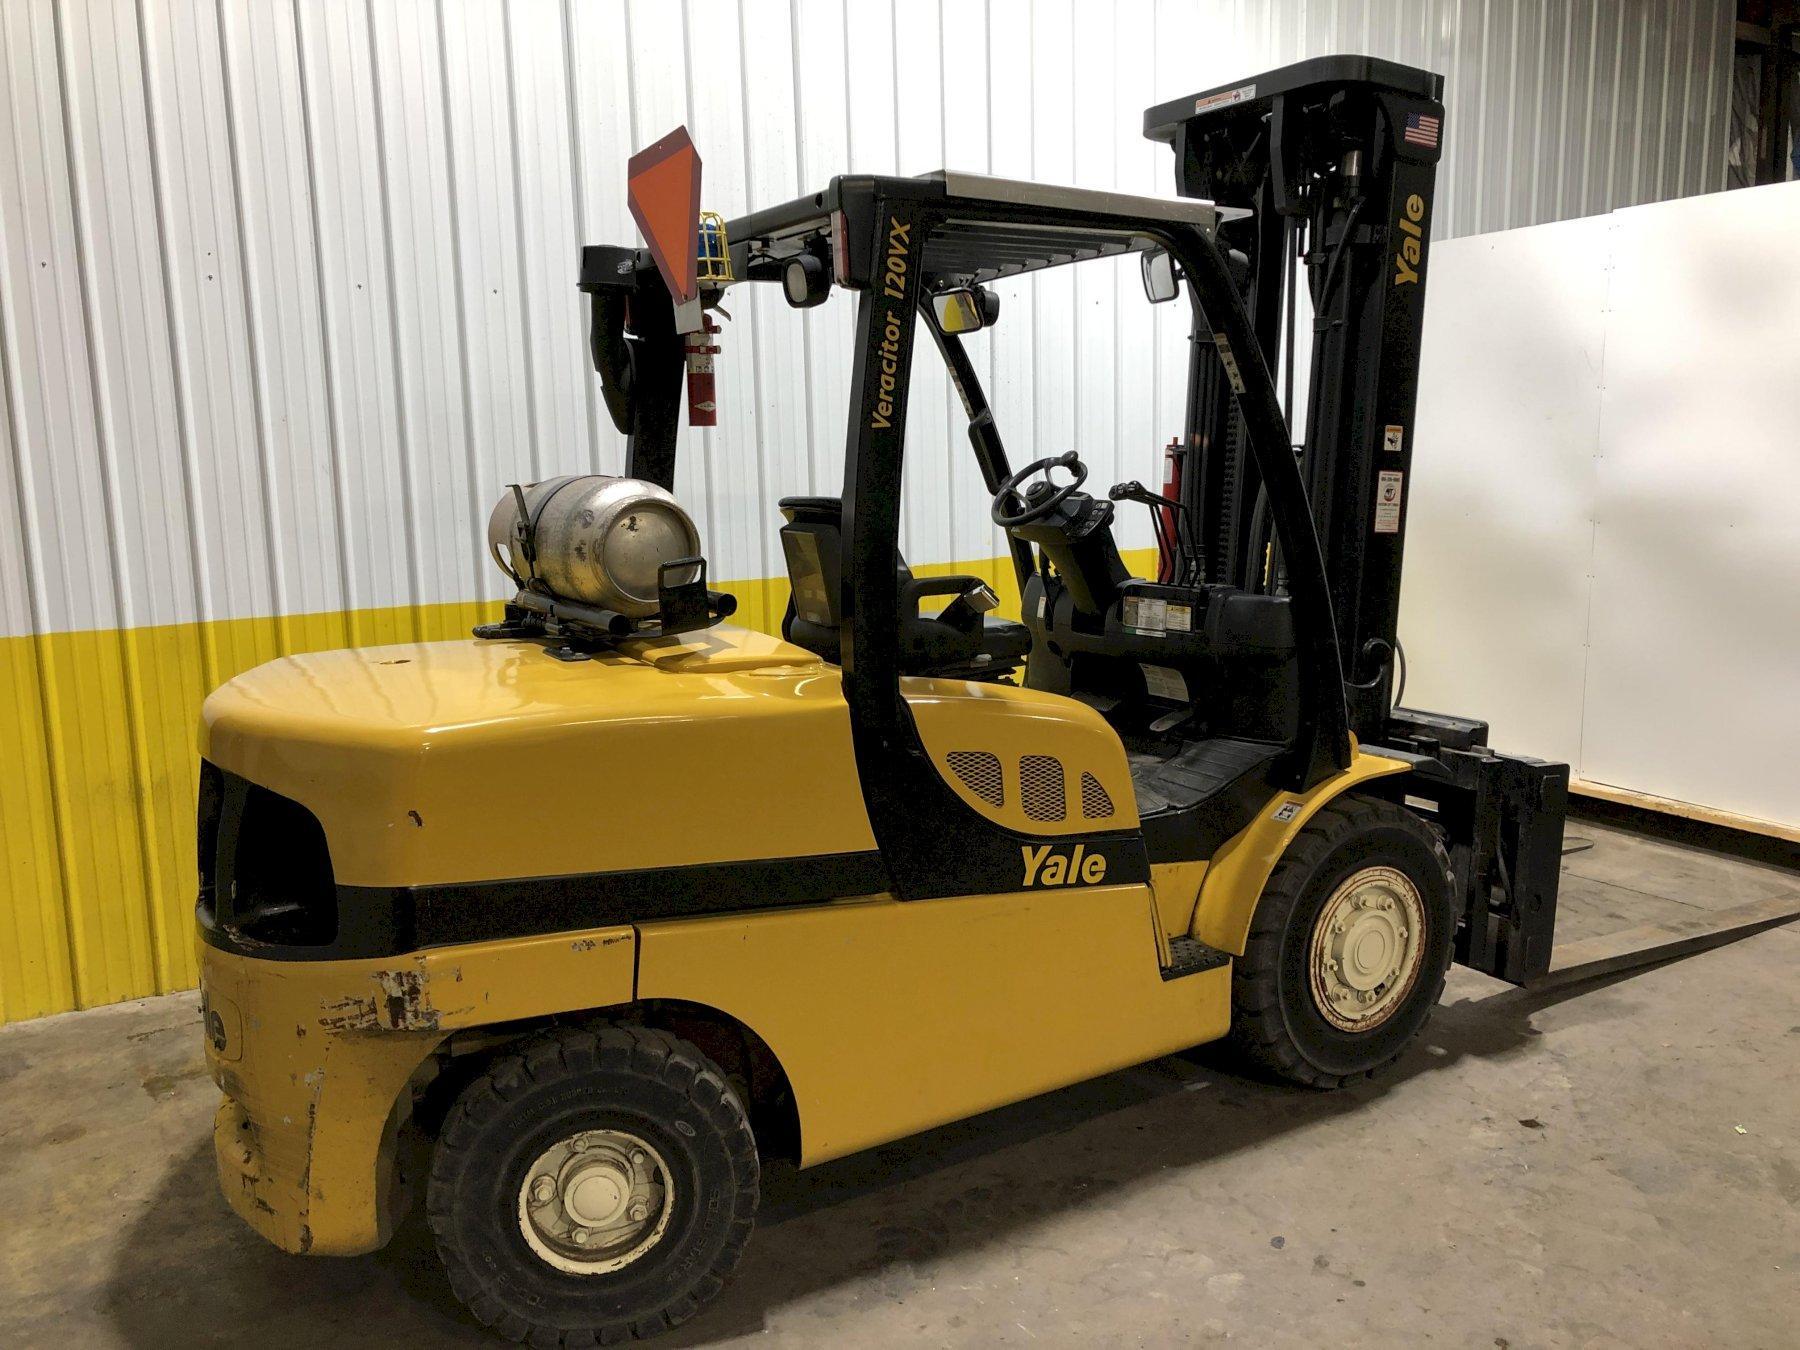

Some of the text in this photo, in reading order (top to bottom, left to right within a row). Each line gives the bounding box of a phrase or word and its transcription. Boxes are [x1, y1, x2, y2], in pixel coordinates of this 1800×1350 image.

[1395, 193, 1425, 286] Yale
[871, 216, 911, 430] Veracitor 120VX
[1021, 844, 1107, 887] Yale
